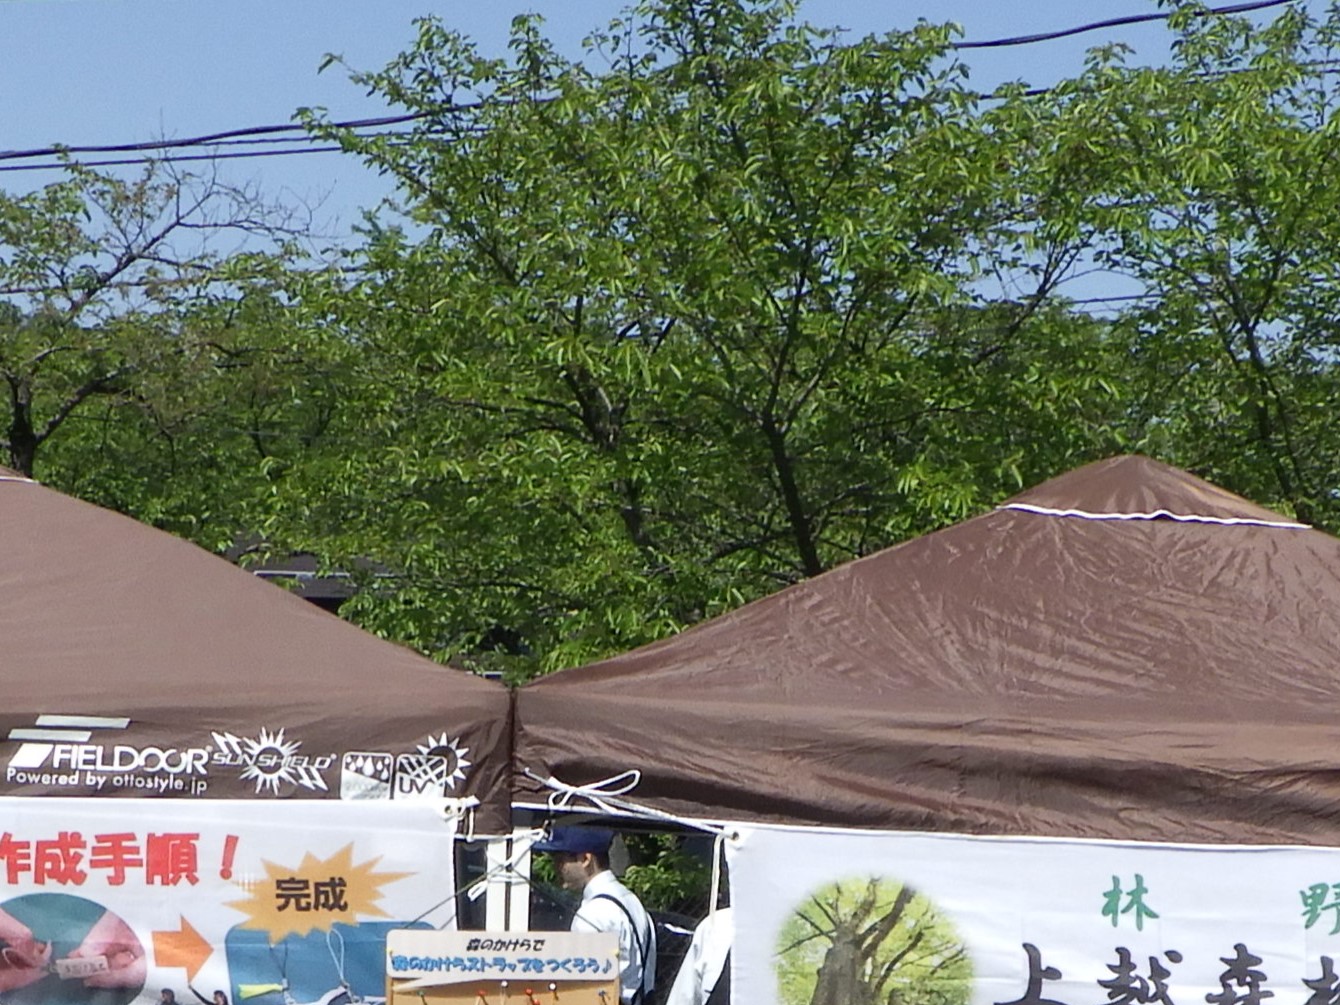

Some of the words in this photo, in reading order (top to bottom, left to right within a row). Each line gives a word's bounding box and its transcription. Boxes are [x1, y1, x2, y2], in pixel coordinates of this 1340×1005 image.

[52, 744, 208, 775] FIELDOOR
[6, 767, 80, 786] Powered
[85, 770, 107, 790] by
[112, 773, 208, 795] ottostyle.jp
[275, 877, 349, 912] 完成
